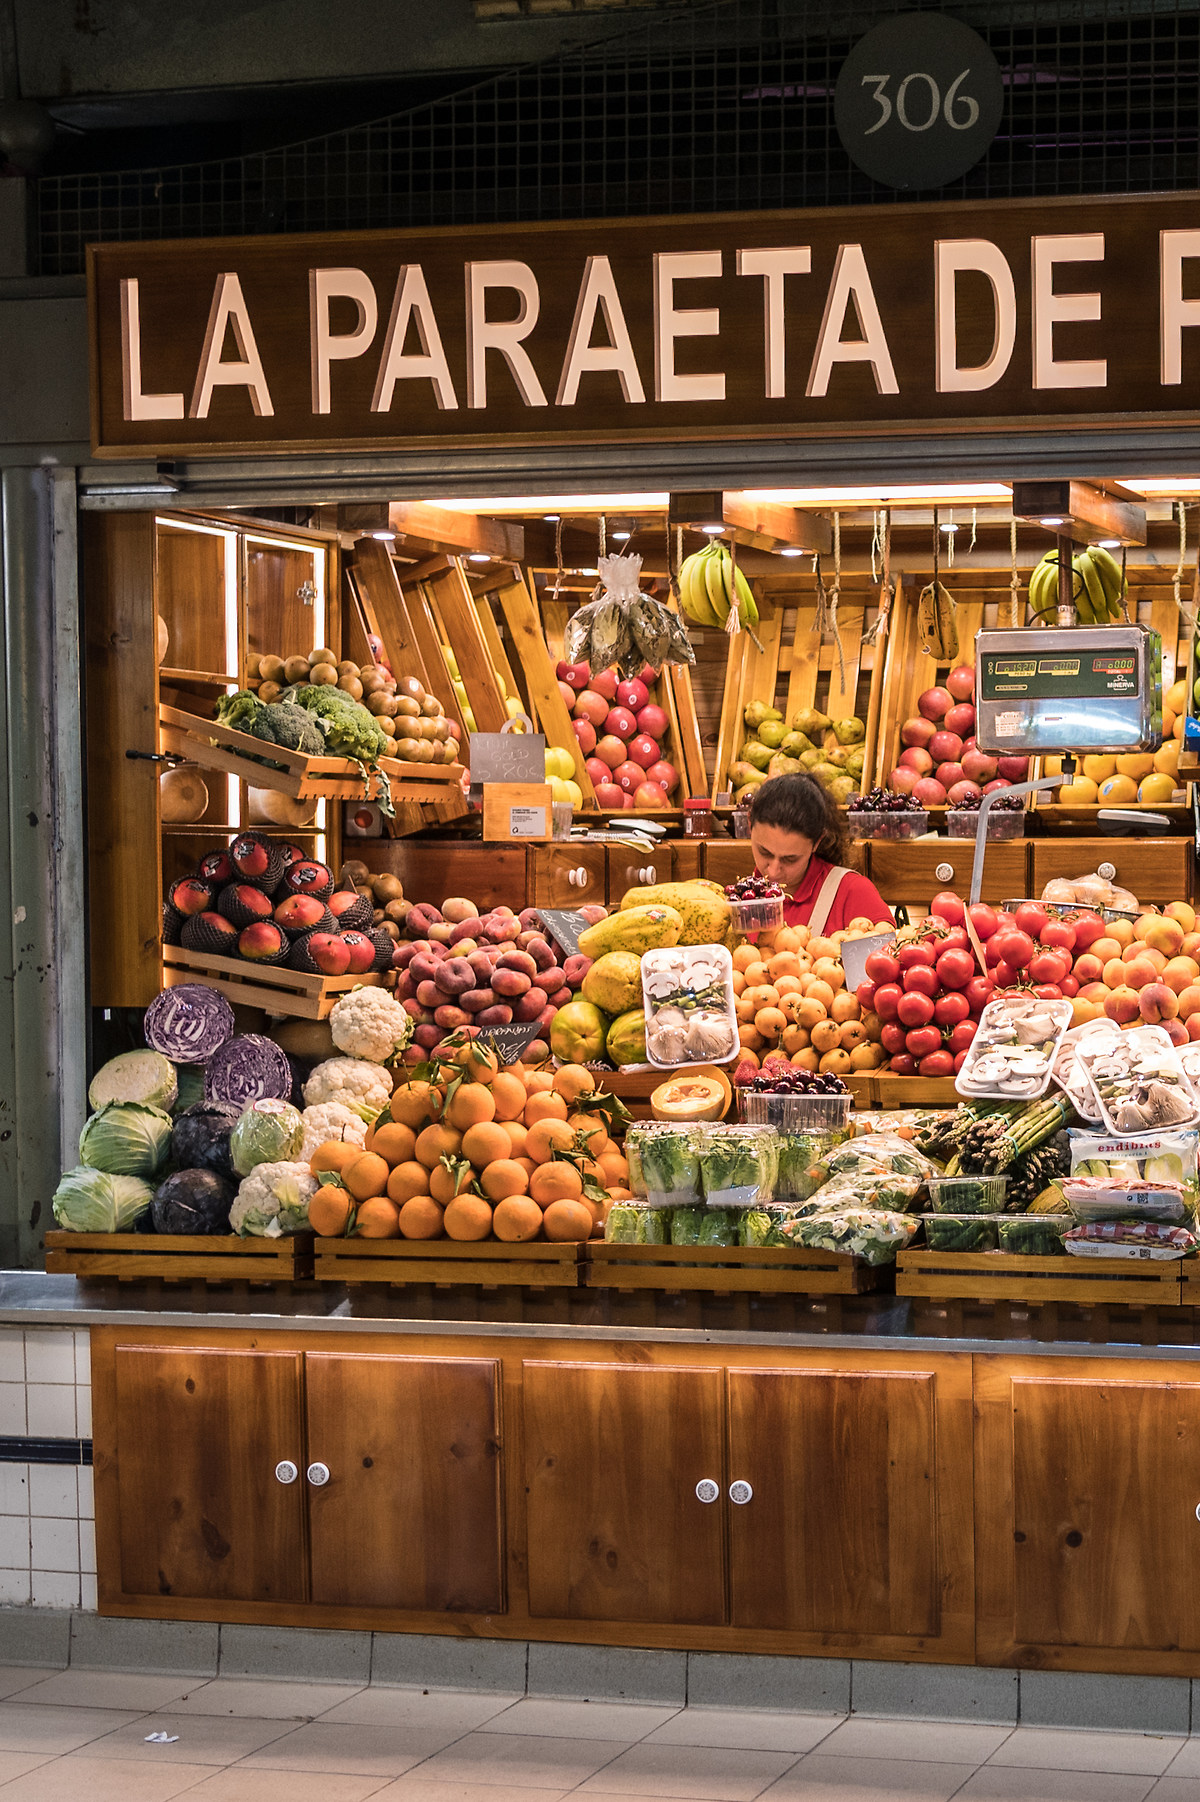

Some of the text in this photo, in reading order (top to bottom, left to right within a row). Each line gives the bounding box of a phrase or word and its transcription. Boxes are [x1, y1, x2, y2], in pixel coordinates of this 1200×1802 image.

[861, 68, 980, 135] 306
[120, 272, 275, 422] LA
[309, 242, 900, 415] PARAETA
[933, 232, 1108, 394] DE
[491, 748, 530, 761] GOLD
